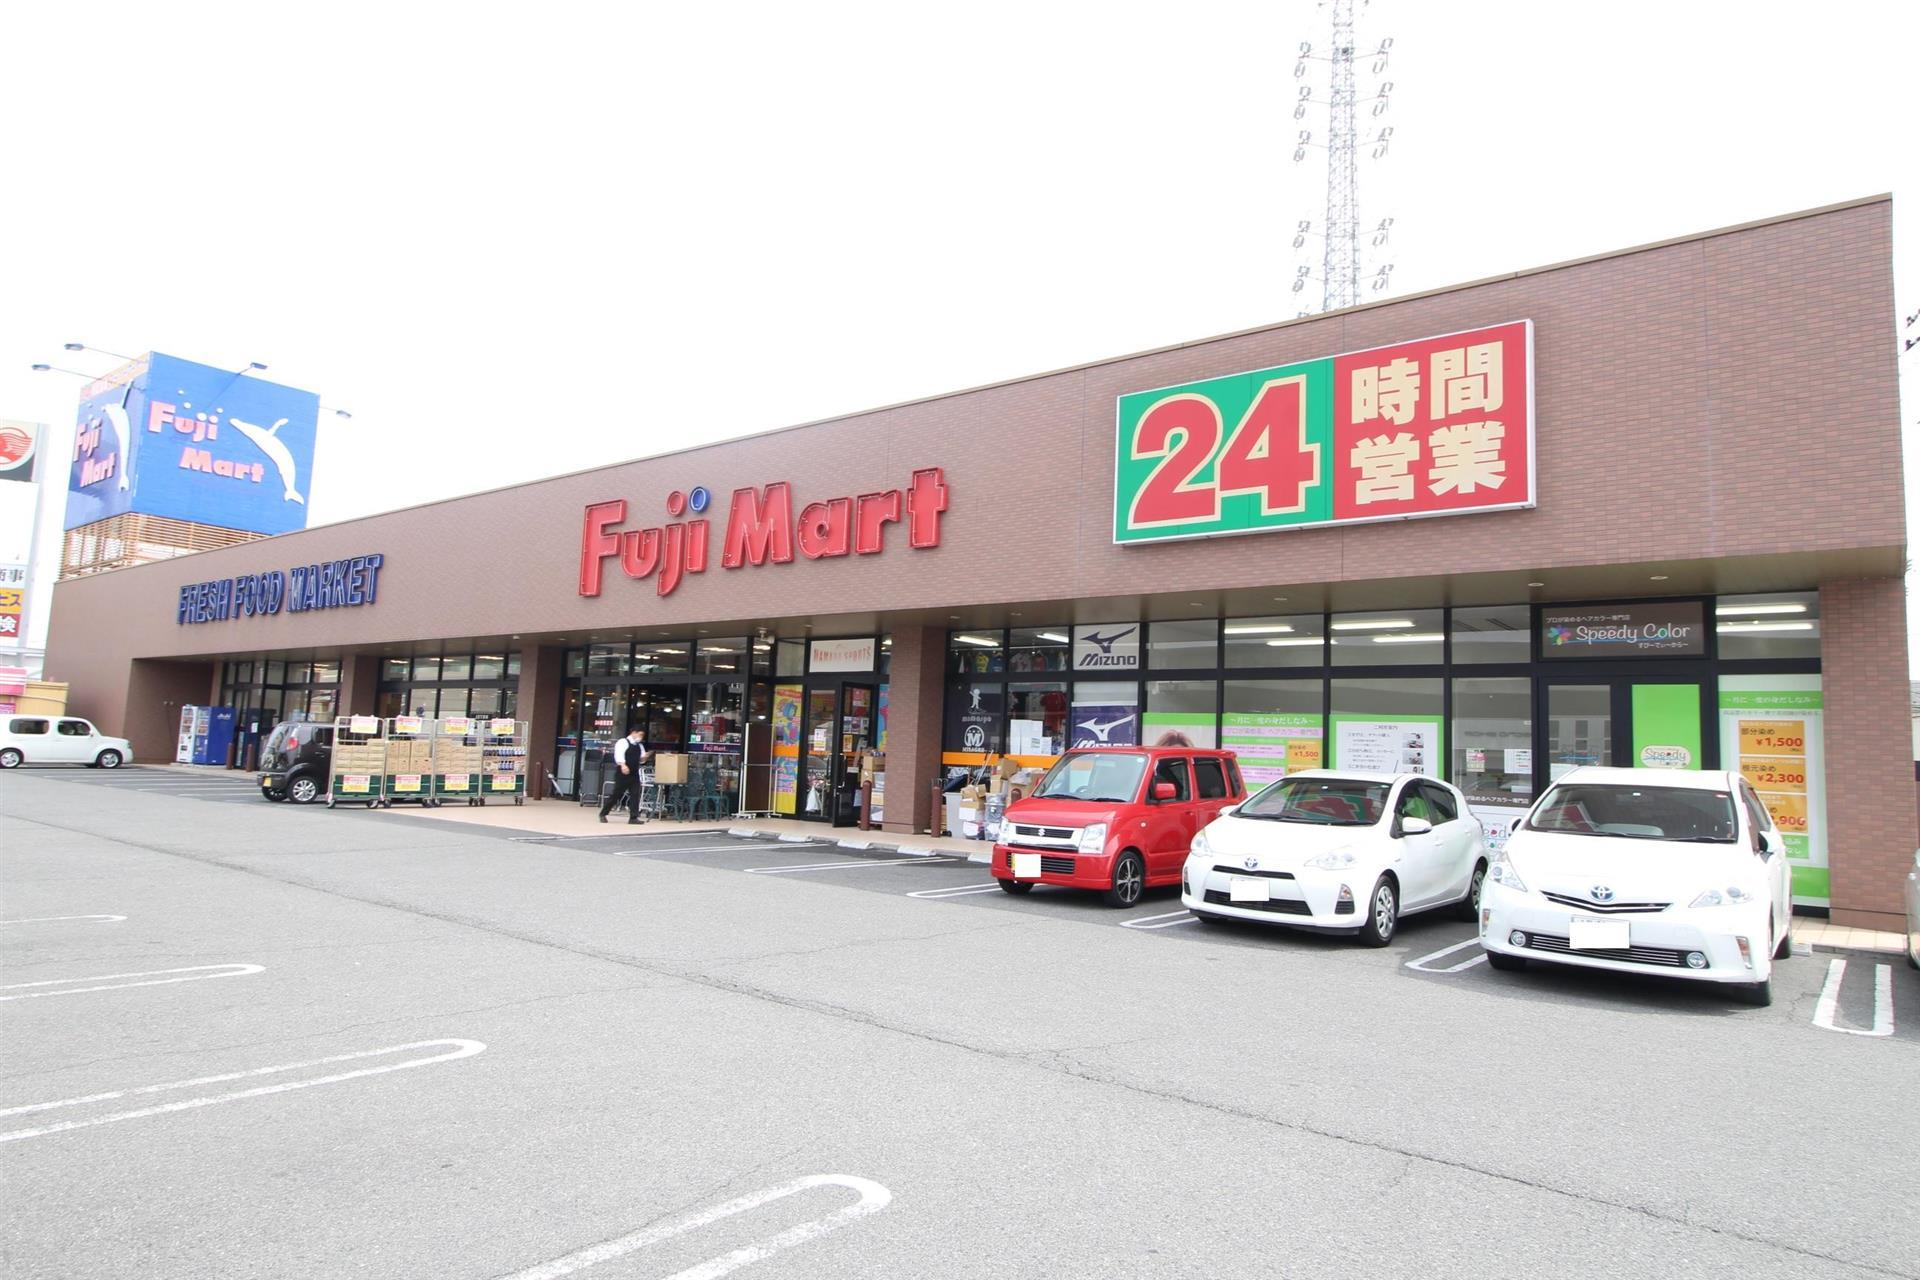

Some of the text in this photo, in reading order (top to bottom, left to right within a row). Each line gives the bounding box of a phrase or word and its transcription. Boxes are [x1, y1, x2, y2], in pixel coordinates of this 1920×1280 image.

[1351, 340, 1504, 426] 時間
[73, 417, 103, 463] Fuji
[148, 400, 219, 442] Fuji
[80, 452, 117, 488] Mart
[178, 447, 265, 483] Mart
[1127, 374, 1321, 530] 24
[1350, 420, 1507, 505] 営業
[578, 467, 949, 597] Fuji Mart
[177, 553, 384, 625] FRESH FOOD MARKET
[1576, 622, 1692, 645] Speedy Color
